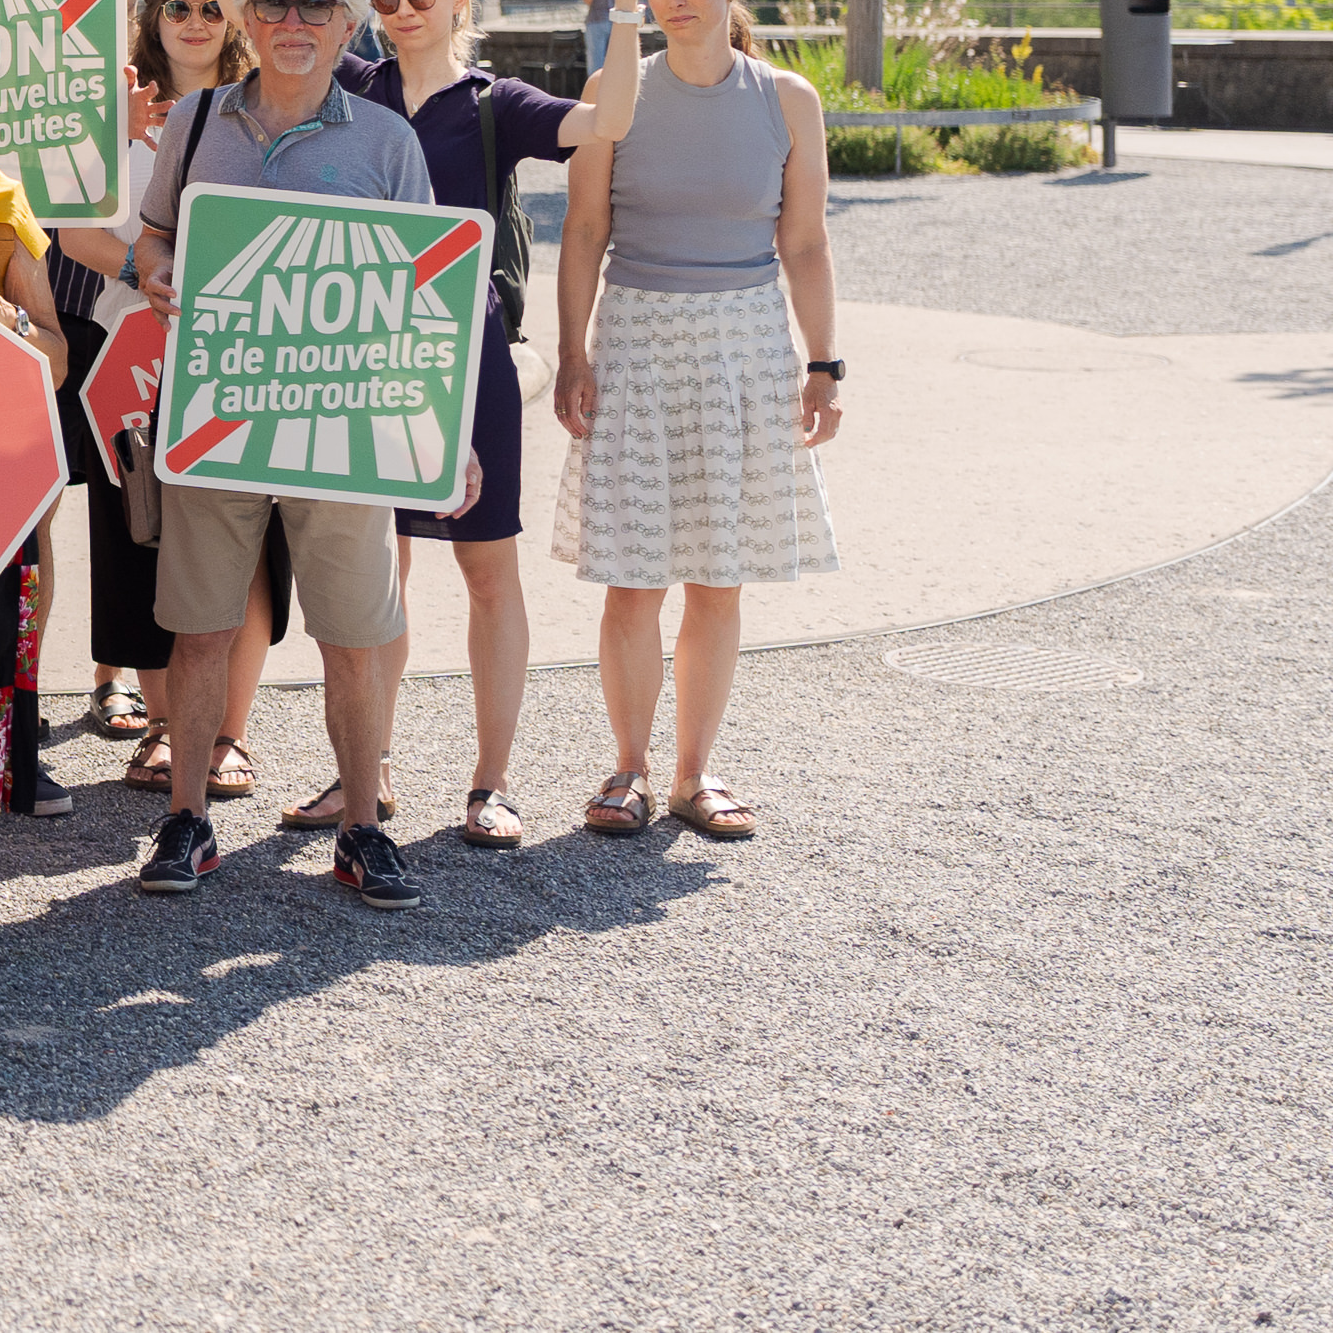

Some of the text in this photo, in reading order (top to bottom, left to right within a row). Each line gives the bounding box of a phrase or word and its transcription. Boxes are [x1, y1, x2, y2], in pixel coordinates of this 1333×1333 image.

[257, 269, 409, 335] NON
[187, 333, 456, 376] à de nouvelles
[220, 376, 425, 413] autoroutes
